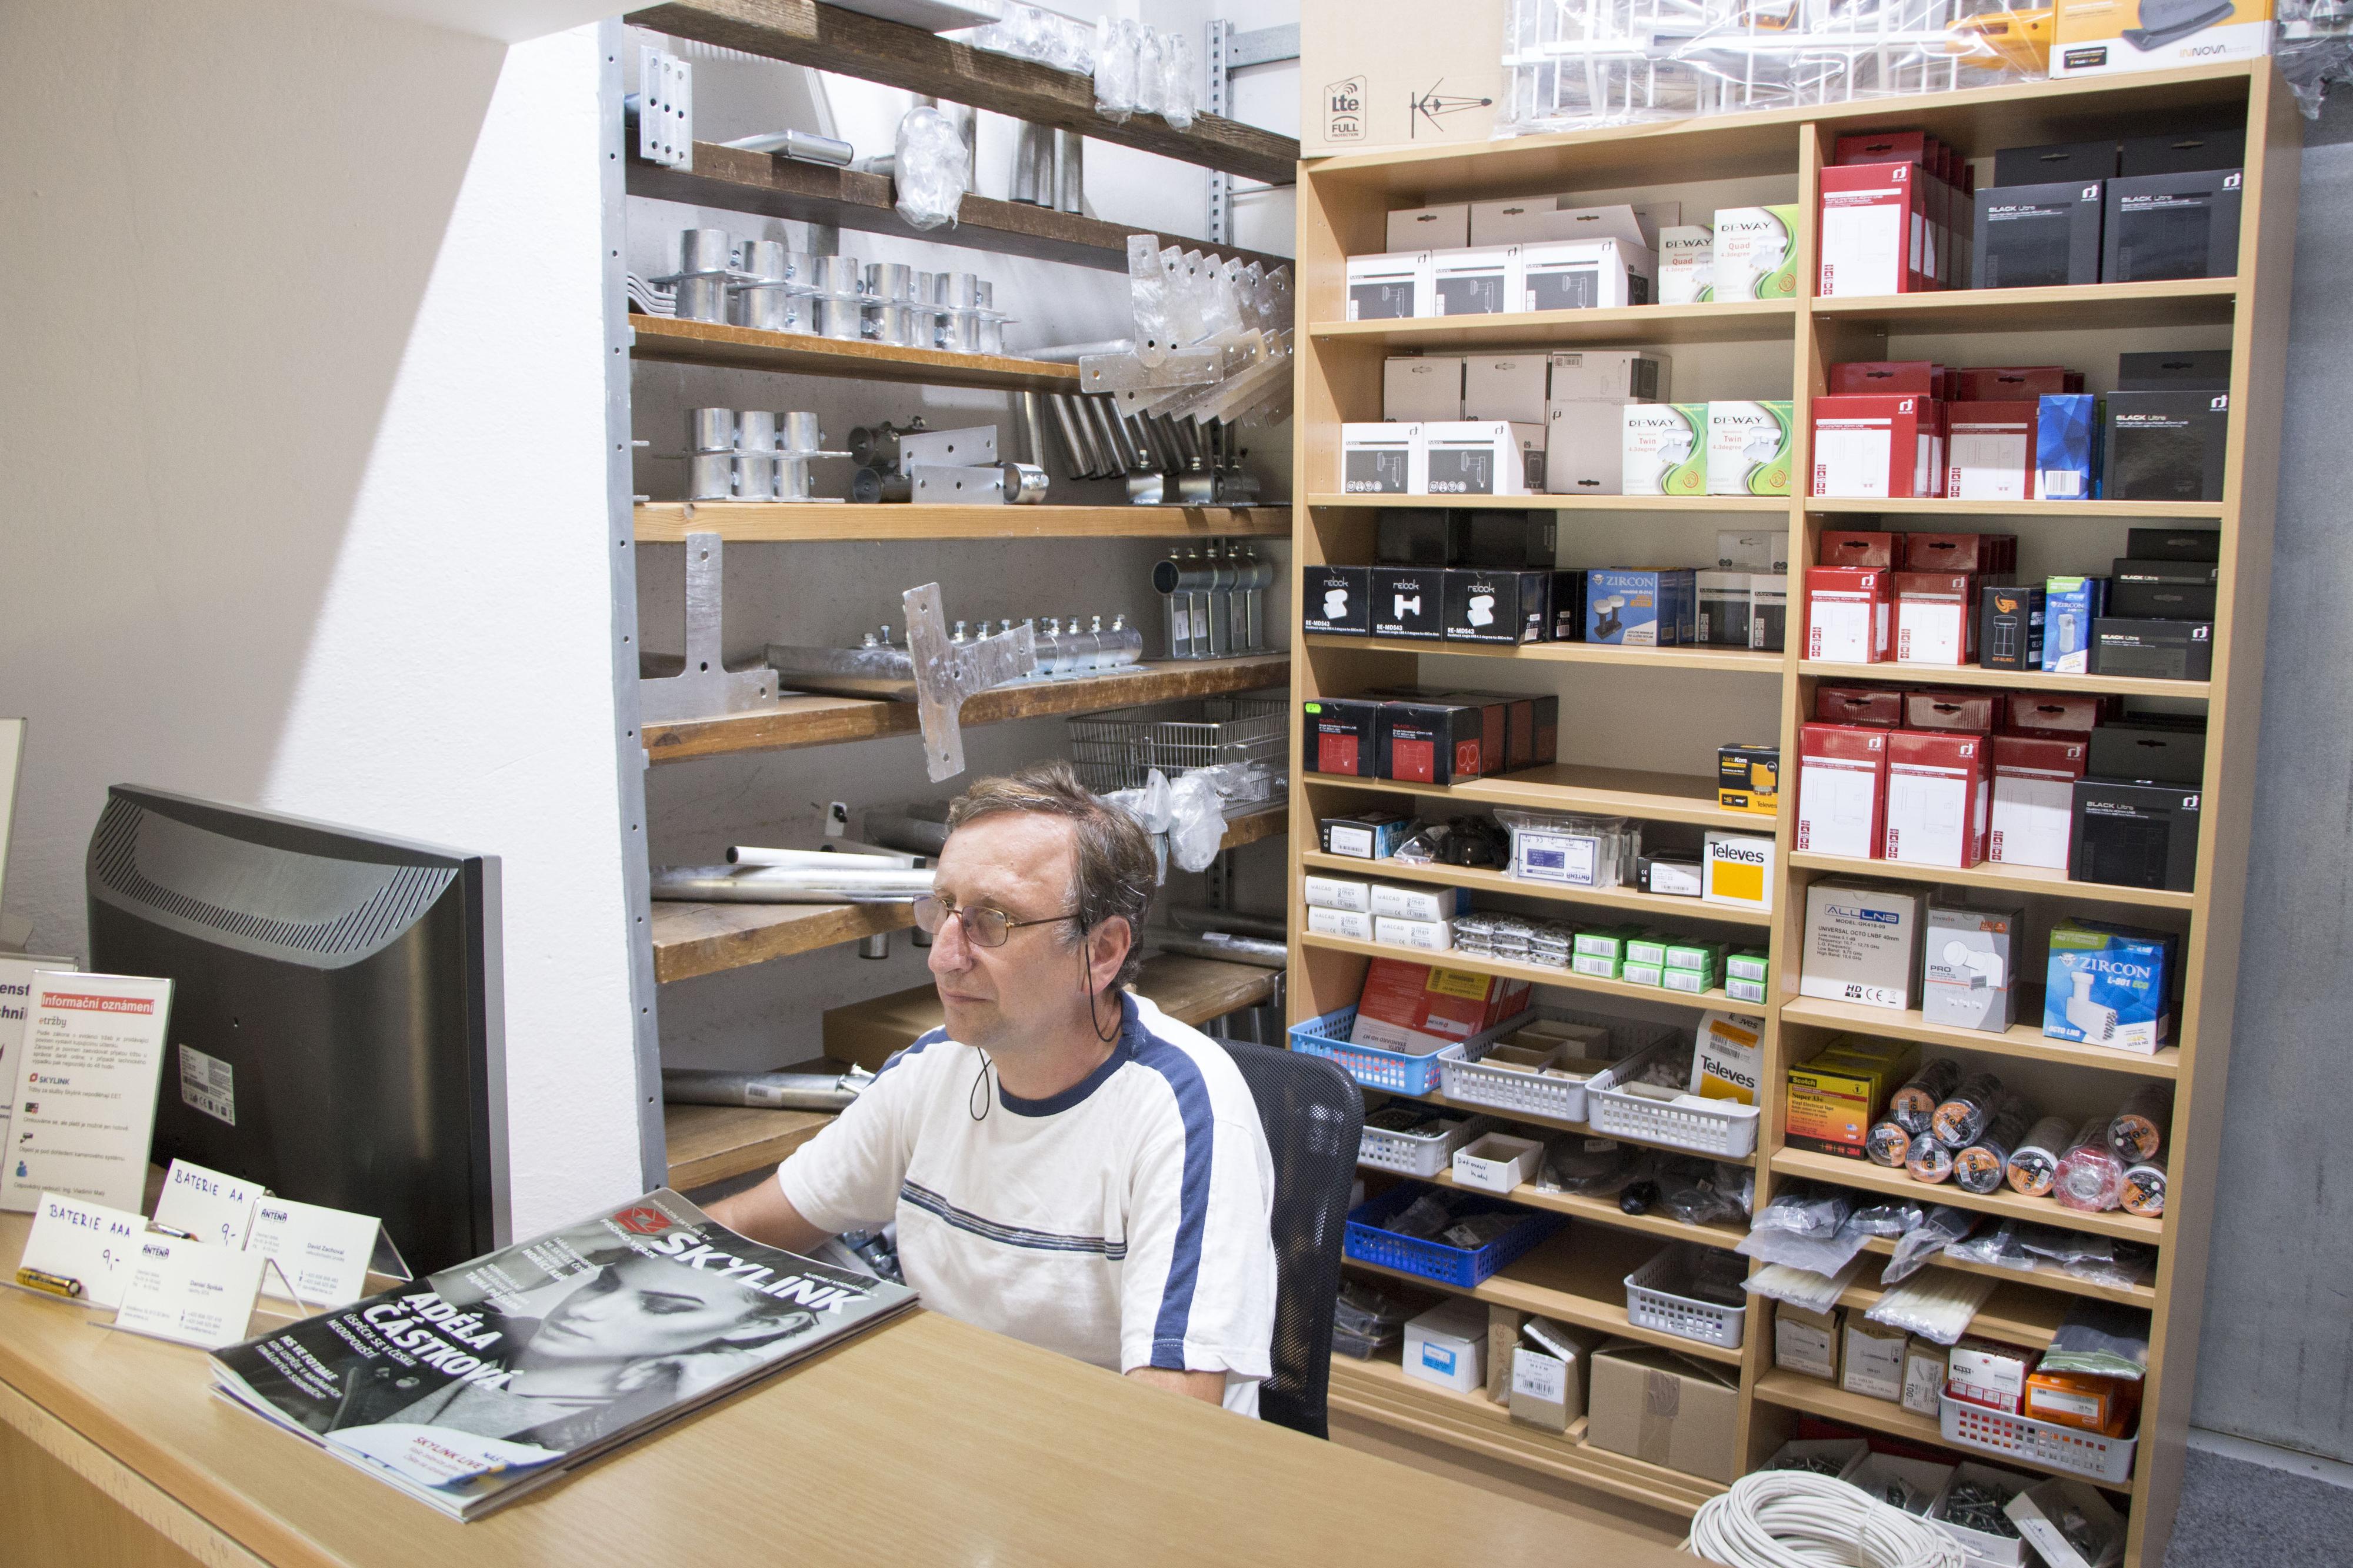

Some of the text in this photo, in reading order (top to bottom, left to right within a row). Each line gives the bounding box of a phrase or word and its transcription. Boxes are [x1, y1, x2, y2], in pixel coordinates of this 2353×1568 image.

[2179, 44, 2226, 58] INNOVA
[1332, 124, 1359, 133] FULL
[1721, 221, 1772, 232] DI-WAY
[1666, 238, 1712, 248] DI-WAY
[1728, 242, 1751, 251] Quad
[1324, 576, 1348, 587] relook
[1393, 579, 1419, 589] relook
[1468, 582, 1495, 593] relook
[1607, 576, 1654, 586] ZIRCON
[1709, 841, 1764, 863] Televes
[1818, 926, 1848, 935] UNIVERSAL
[2079, 956, 2151, 978] ZIRCON
[42, 994, 154, 1013] Informační oznámení
[39, 1016, 67, 1028] etržby
[1380, 1036, 1407, 1046] STANDARD
[1701, 1055, 1755, 1088] Televes
[39, 1076, 71, 1085] SKYLINK
[1792, 1077, 1816, 1086] Scotch
[1792, 1092, 1811, 1100] Super
[1847, 1147, 1861, 1156] 3M
[175, 1169, 243, 1204] BATERIE AA
[49, 1204, 131, 1239] BATERIE AAA
[261, 1209, 287, 1222] ANTÉNA
[676, 1219, 704, 1236] SKYLINK
[599, 1218, 659, 1259] PROMO VERZE
[142, 1244, 169, 1257] ANTÉNA
[650, 1231, 872, 1315] SKYLINK
[465, 1272, 492, 1290] TAJNÁ
[402, 1292, 502, 1351] ADÉLA
[326, 1318, 381, 1360] NEODPOUŠTÍ
[342, 1313, 418, 1368] ÚSPĚCH SE V ČESKU
[267, 1340, 284, 1352] KDO
[362, 1301, 524, 1391] ČÁSTKOVÁ
[279, 1335, 339, 1382] MS VE FOTBALE
[412, 1436, 459, 1462] SKYLINK
[459, 1456, 485, 1469] LIVE
